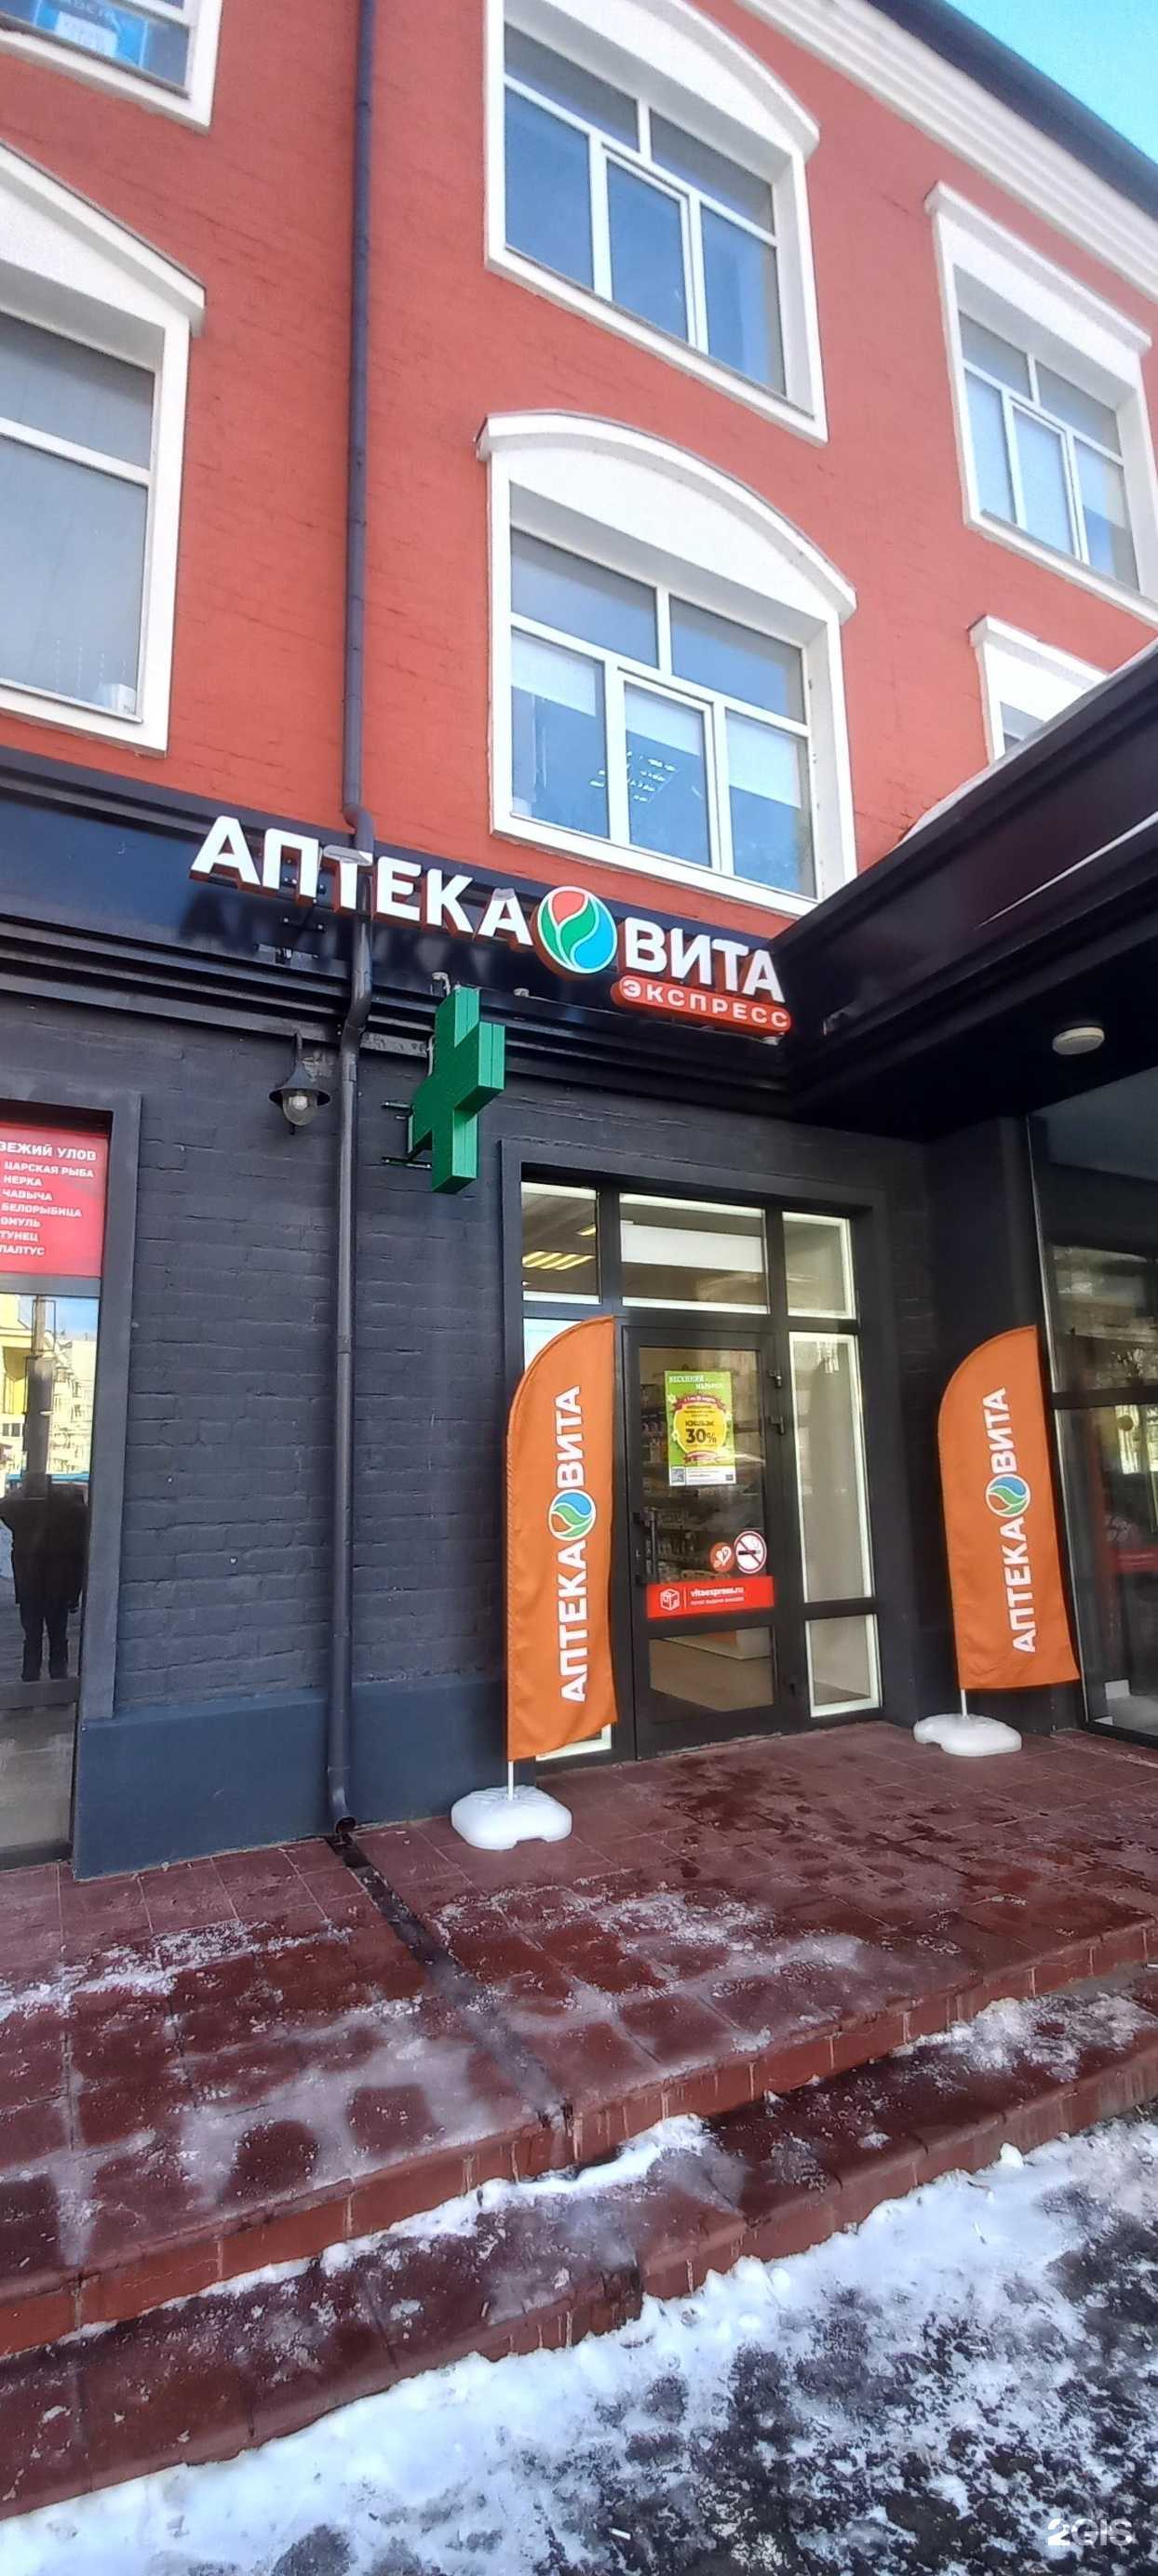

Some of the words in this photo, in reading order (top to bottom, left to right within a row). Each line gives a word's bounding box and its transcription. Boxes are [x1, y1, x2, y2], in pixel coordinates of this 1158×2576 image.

[190, 815, 532, 947] АПТЕКА
[625, 917, 788, 1004] ВИТА
[622, 979, 790, 1029] ЭКСПРЕСС
[57, 1147, 98, 1161] УЛОВ
[4, 1161, 60, 1174] ЦАРСКАЯ
[61, 1166, 95, 1178] РЫБА
[3, 1174, 43, 1187] НЕРКА
[2, 1187, 53, 1201] ЧАВЫЧА
[1, 1201, 83, 1217] БЕЛОРЫБИЦА
[0, 1216, 41, 1228] ОМУЛЬ
[0, 1229, 39, 1242] ТУНЕЦ
[555, 1384, 585, 1490] ВИТА
[685, 1429, 717, 1443] 30%
[982, 1387, 1018, 1474] ВИТА
[999, 1516, 1037, 1654] АПТЕКА
[558, 1539, 589, 1704] АПТЕКА
